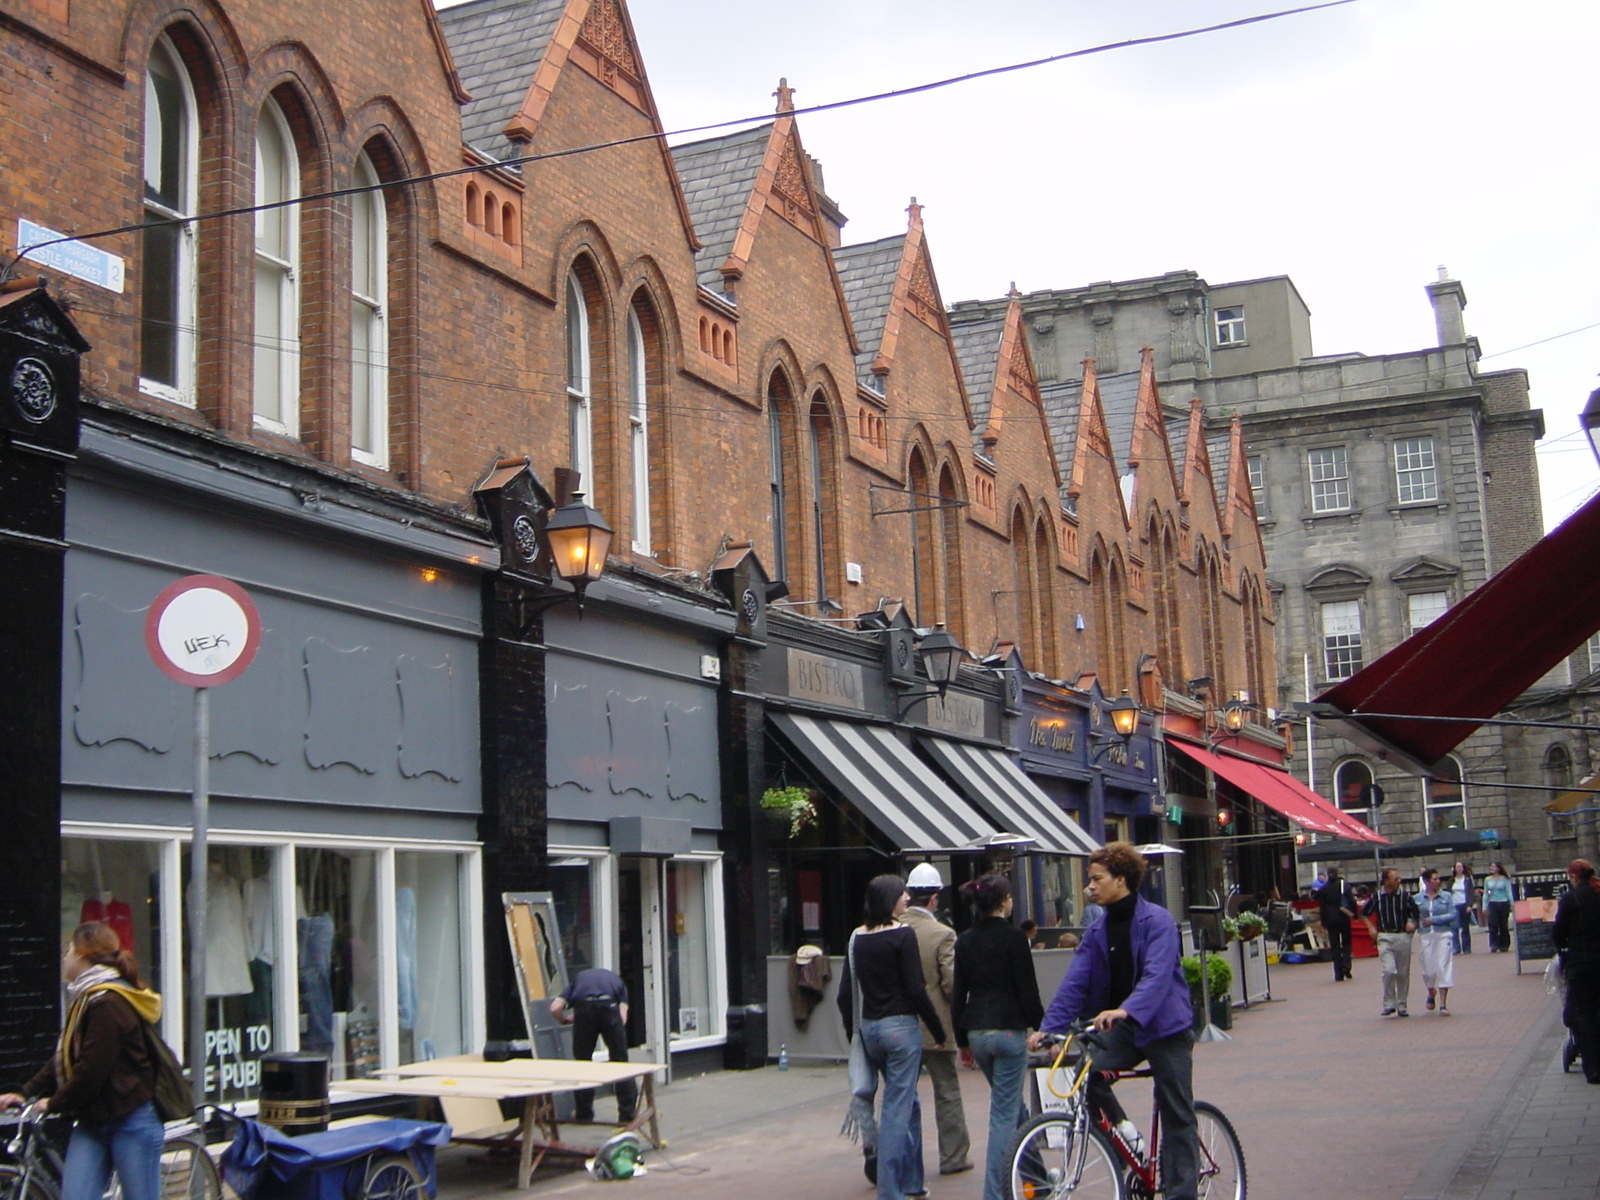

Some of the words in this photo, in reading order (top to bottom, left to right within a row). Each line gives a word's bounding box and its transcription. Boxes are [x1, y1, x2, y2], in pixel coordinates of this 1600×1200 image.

[26, 242, 62, 267] ASTLE
[65, 257, 103, 281] MARKET
[111, 265, 120, 282] 2
[798, 658, 855, 699] BISTRO
[934, 695, 979, 729] BISTRO
[204, 1027, 241, 1057] PEN
[246, 1024, 271, 1052] TO
